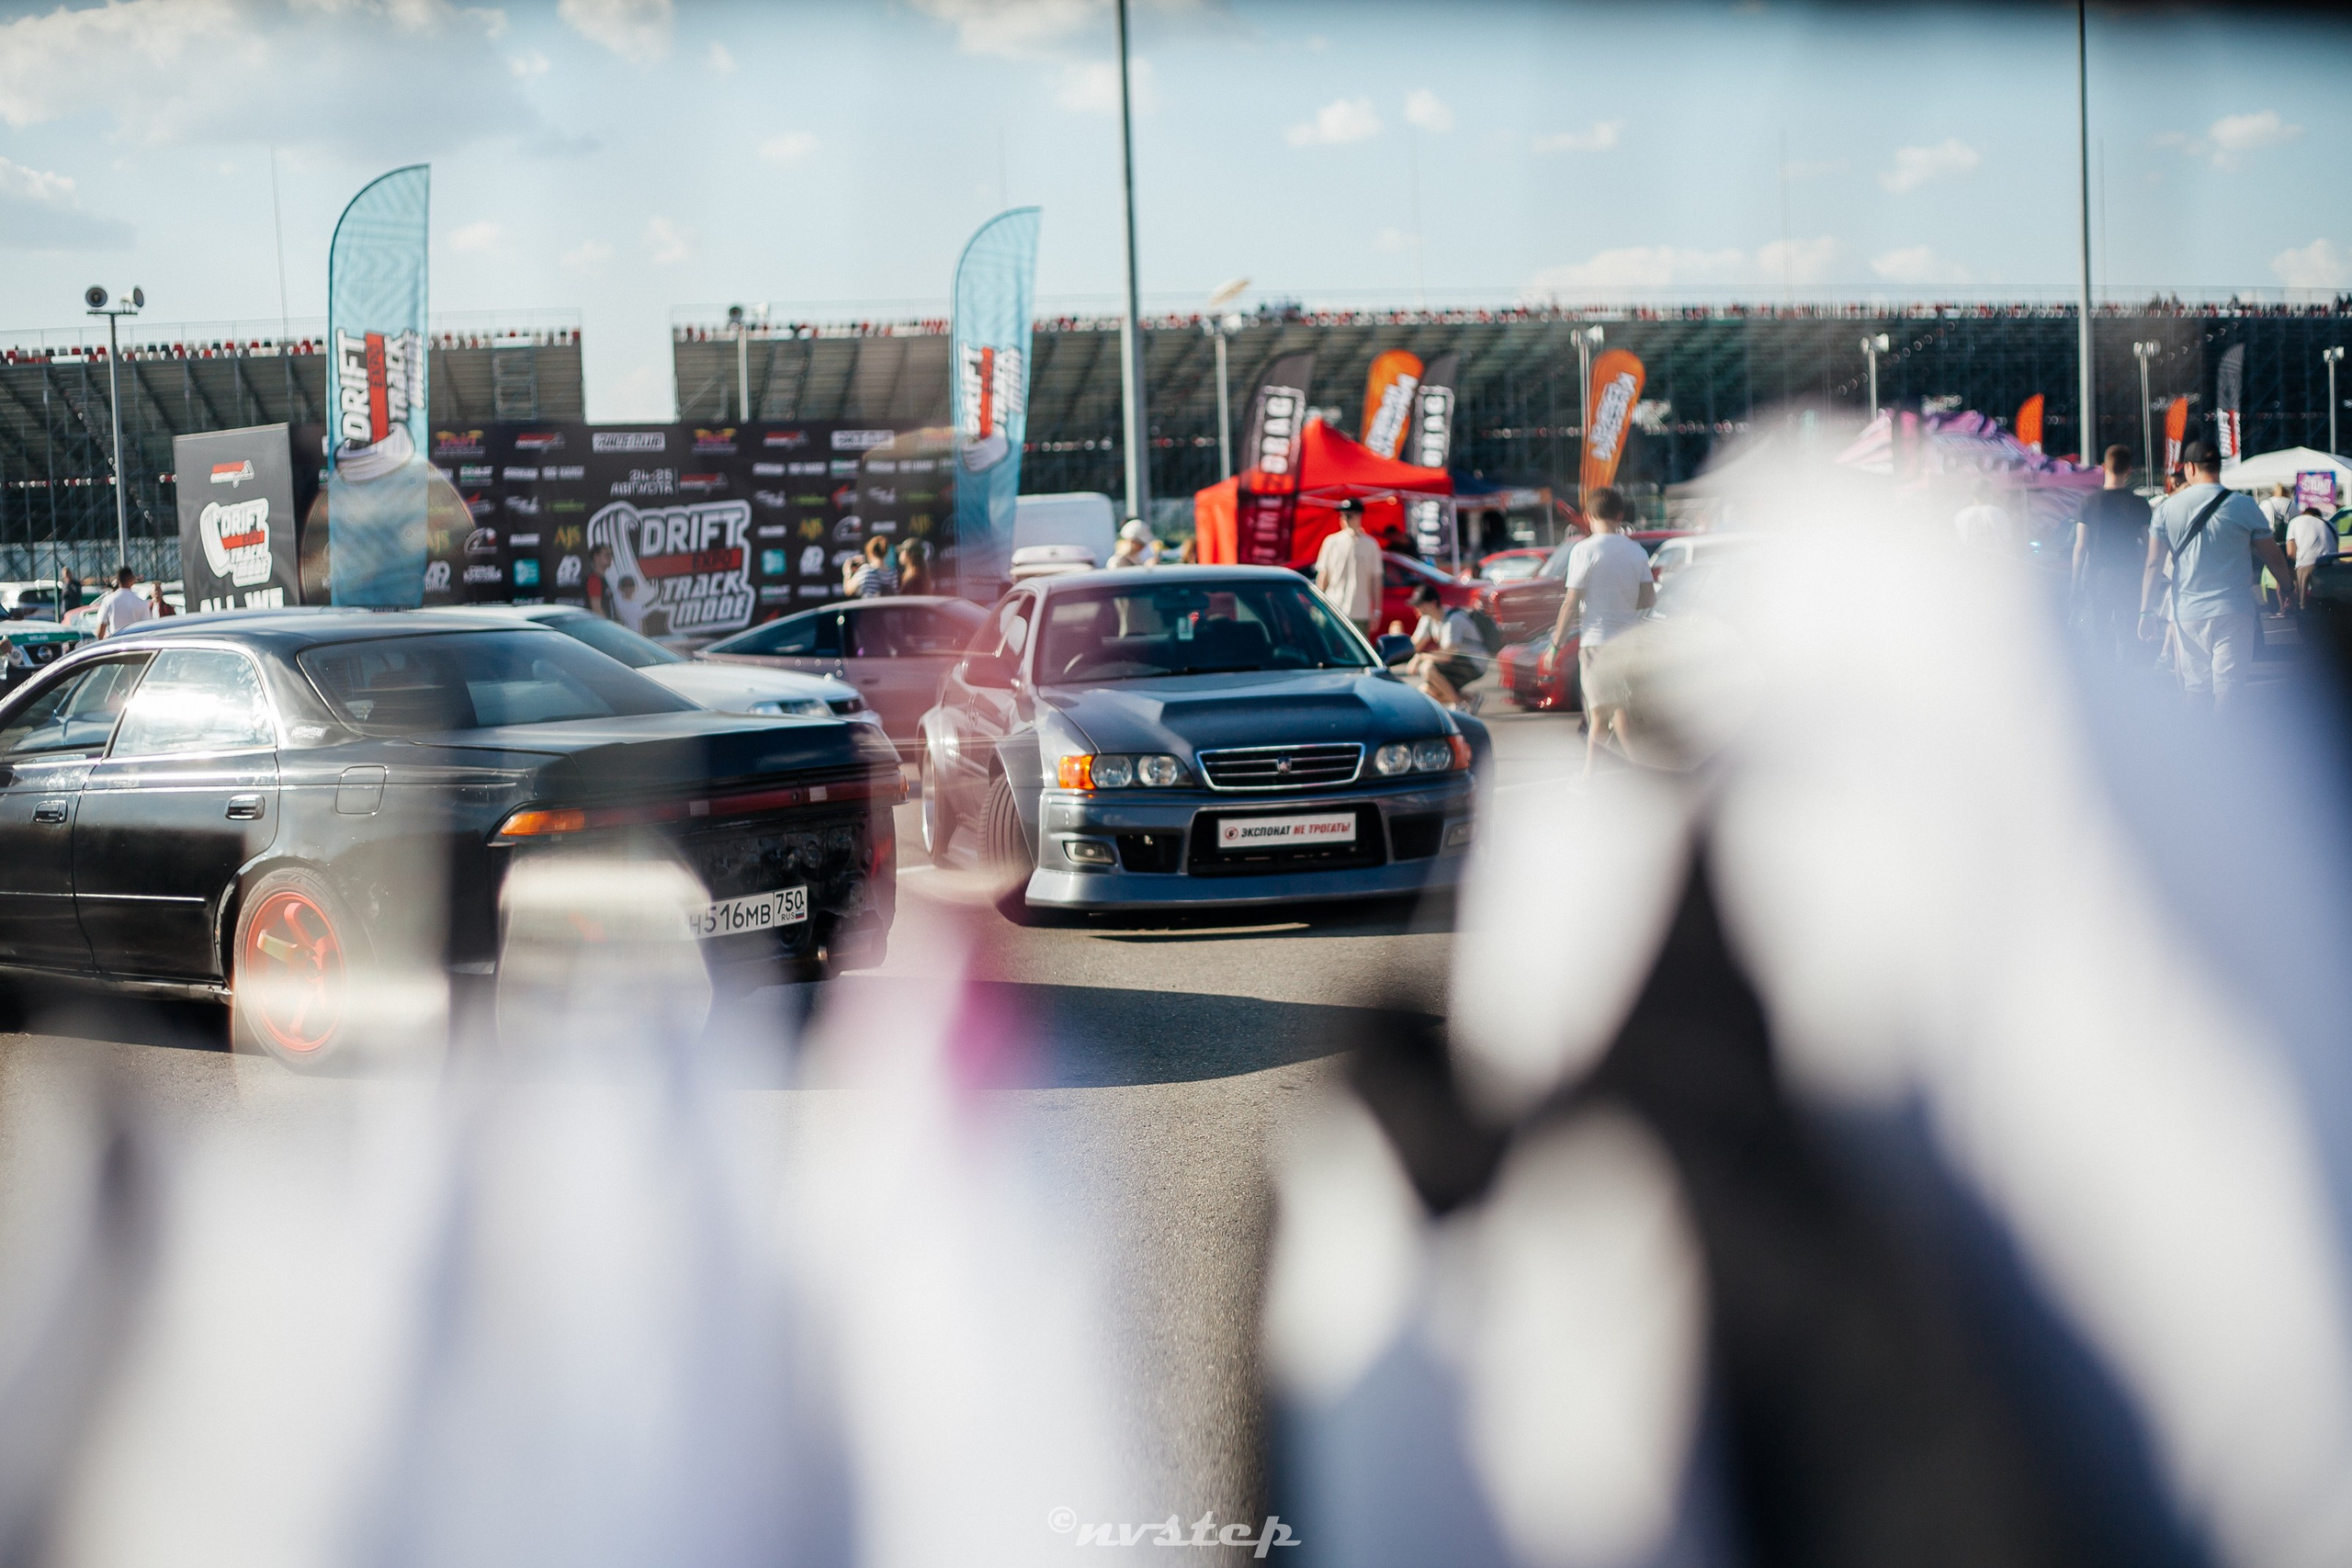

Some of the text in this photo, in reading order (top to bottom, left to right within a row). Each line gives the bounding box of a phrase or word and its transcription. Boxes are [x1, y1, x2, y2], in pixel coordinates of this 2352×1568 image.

[336, 328, 371, 443] DRIFT
[384, 333, 410, 423] TRACK
[220, 504, 266, 538] DRIFT
[639, 511, 743, 558] DRIFT
[661, 570, 741, 603] TRACK
[674, 592, 747, 627] MODE
[1241, 822, 1351, 838] ЭКСПОНАТ НЕ ТРОГАТЬ!
[775, 889, 805, 915] 750
[781, 913, 796, 922] RUS
